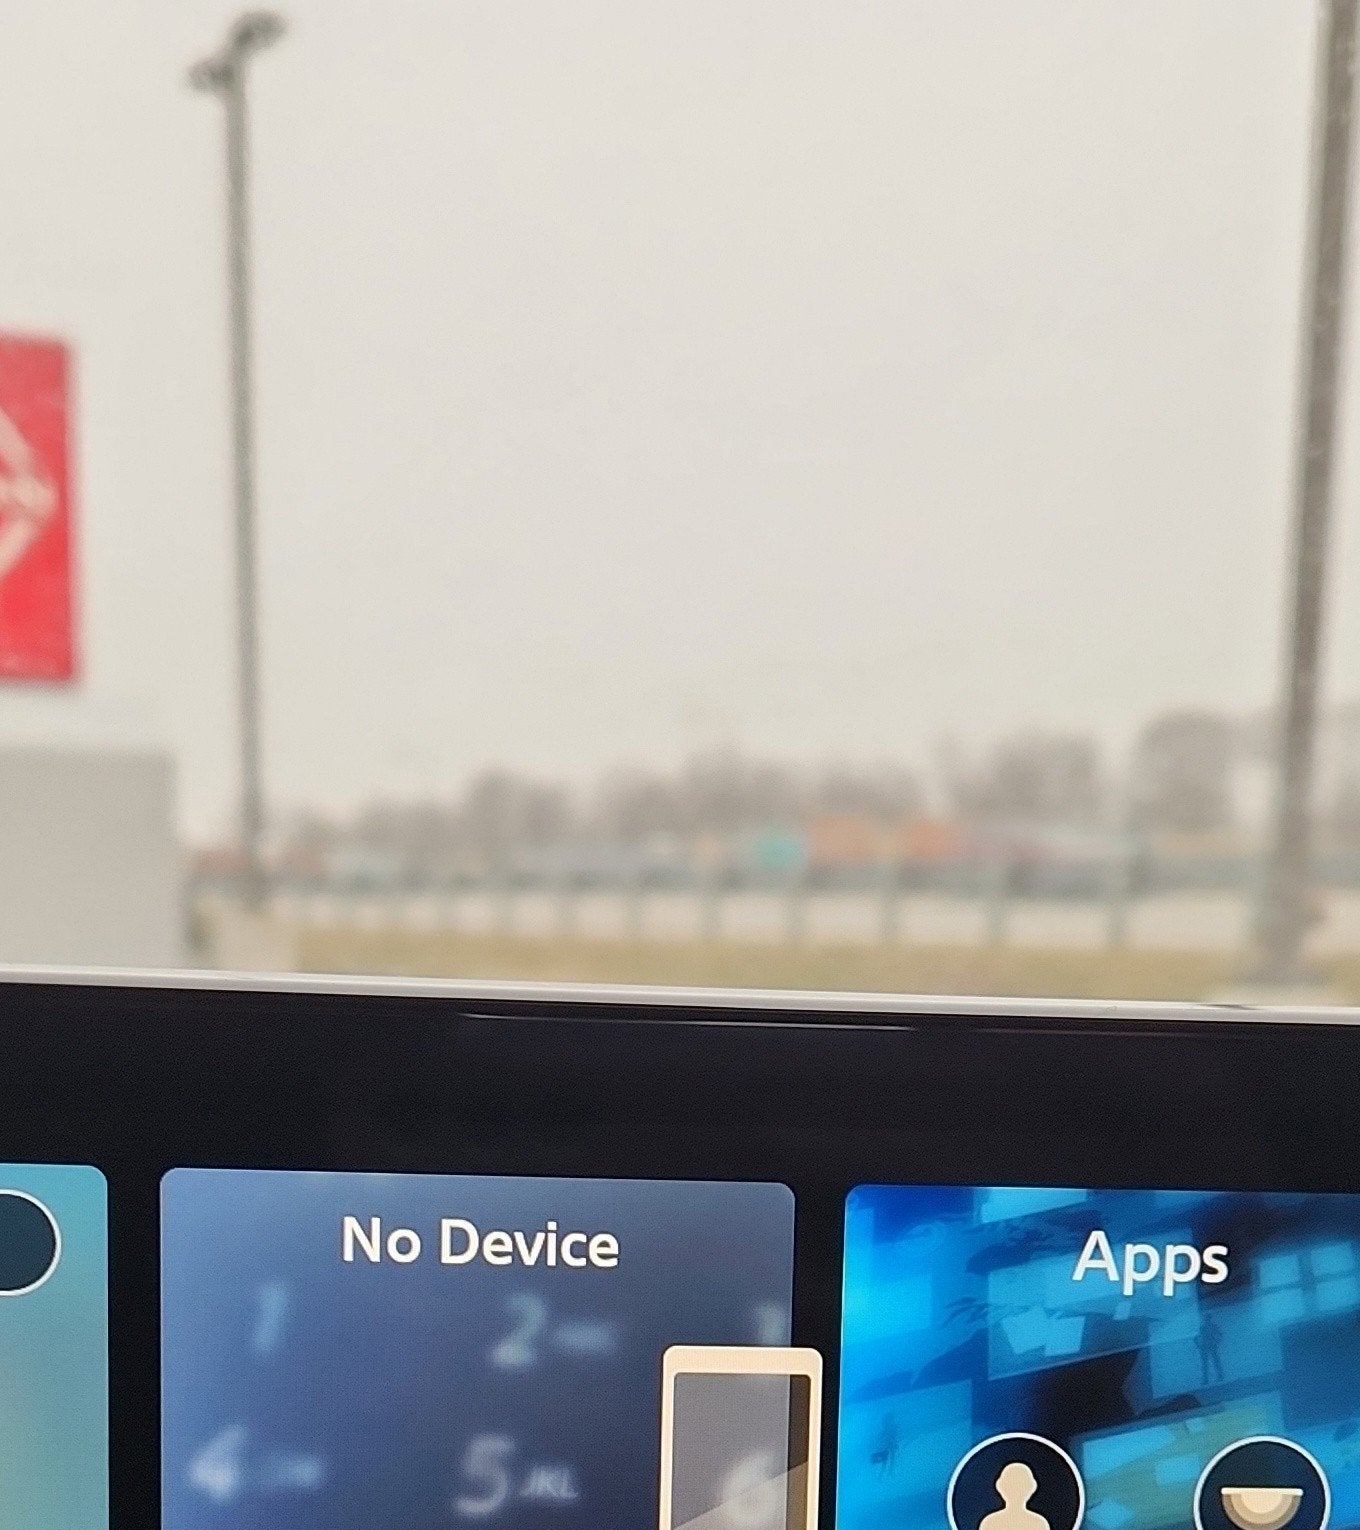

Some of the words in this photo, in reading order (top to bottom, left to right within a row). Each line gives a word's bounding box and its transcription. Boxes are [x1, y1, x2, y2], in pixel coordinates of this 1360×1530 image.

[342, 1215, 422, 1264] No
[439, 1217, 620, 1269] Device
[1071, 1229, 1230, 1296] Apps
[490, 1292, 545, 1368] 2
[452, 1433, 515, 1518] 5
